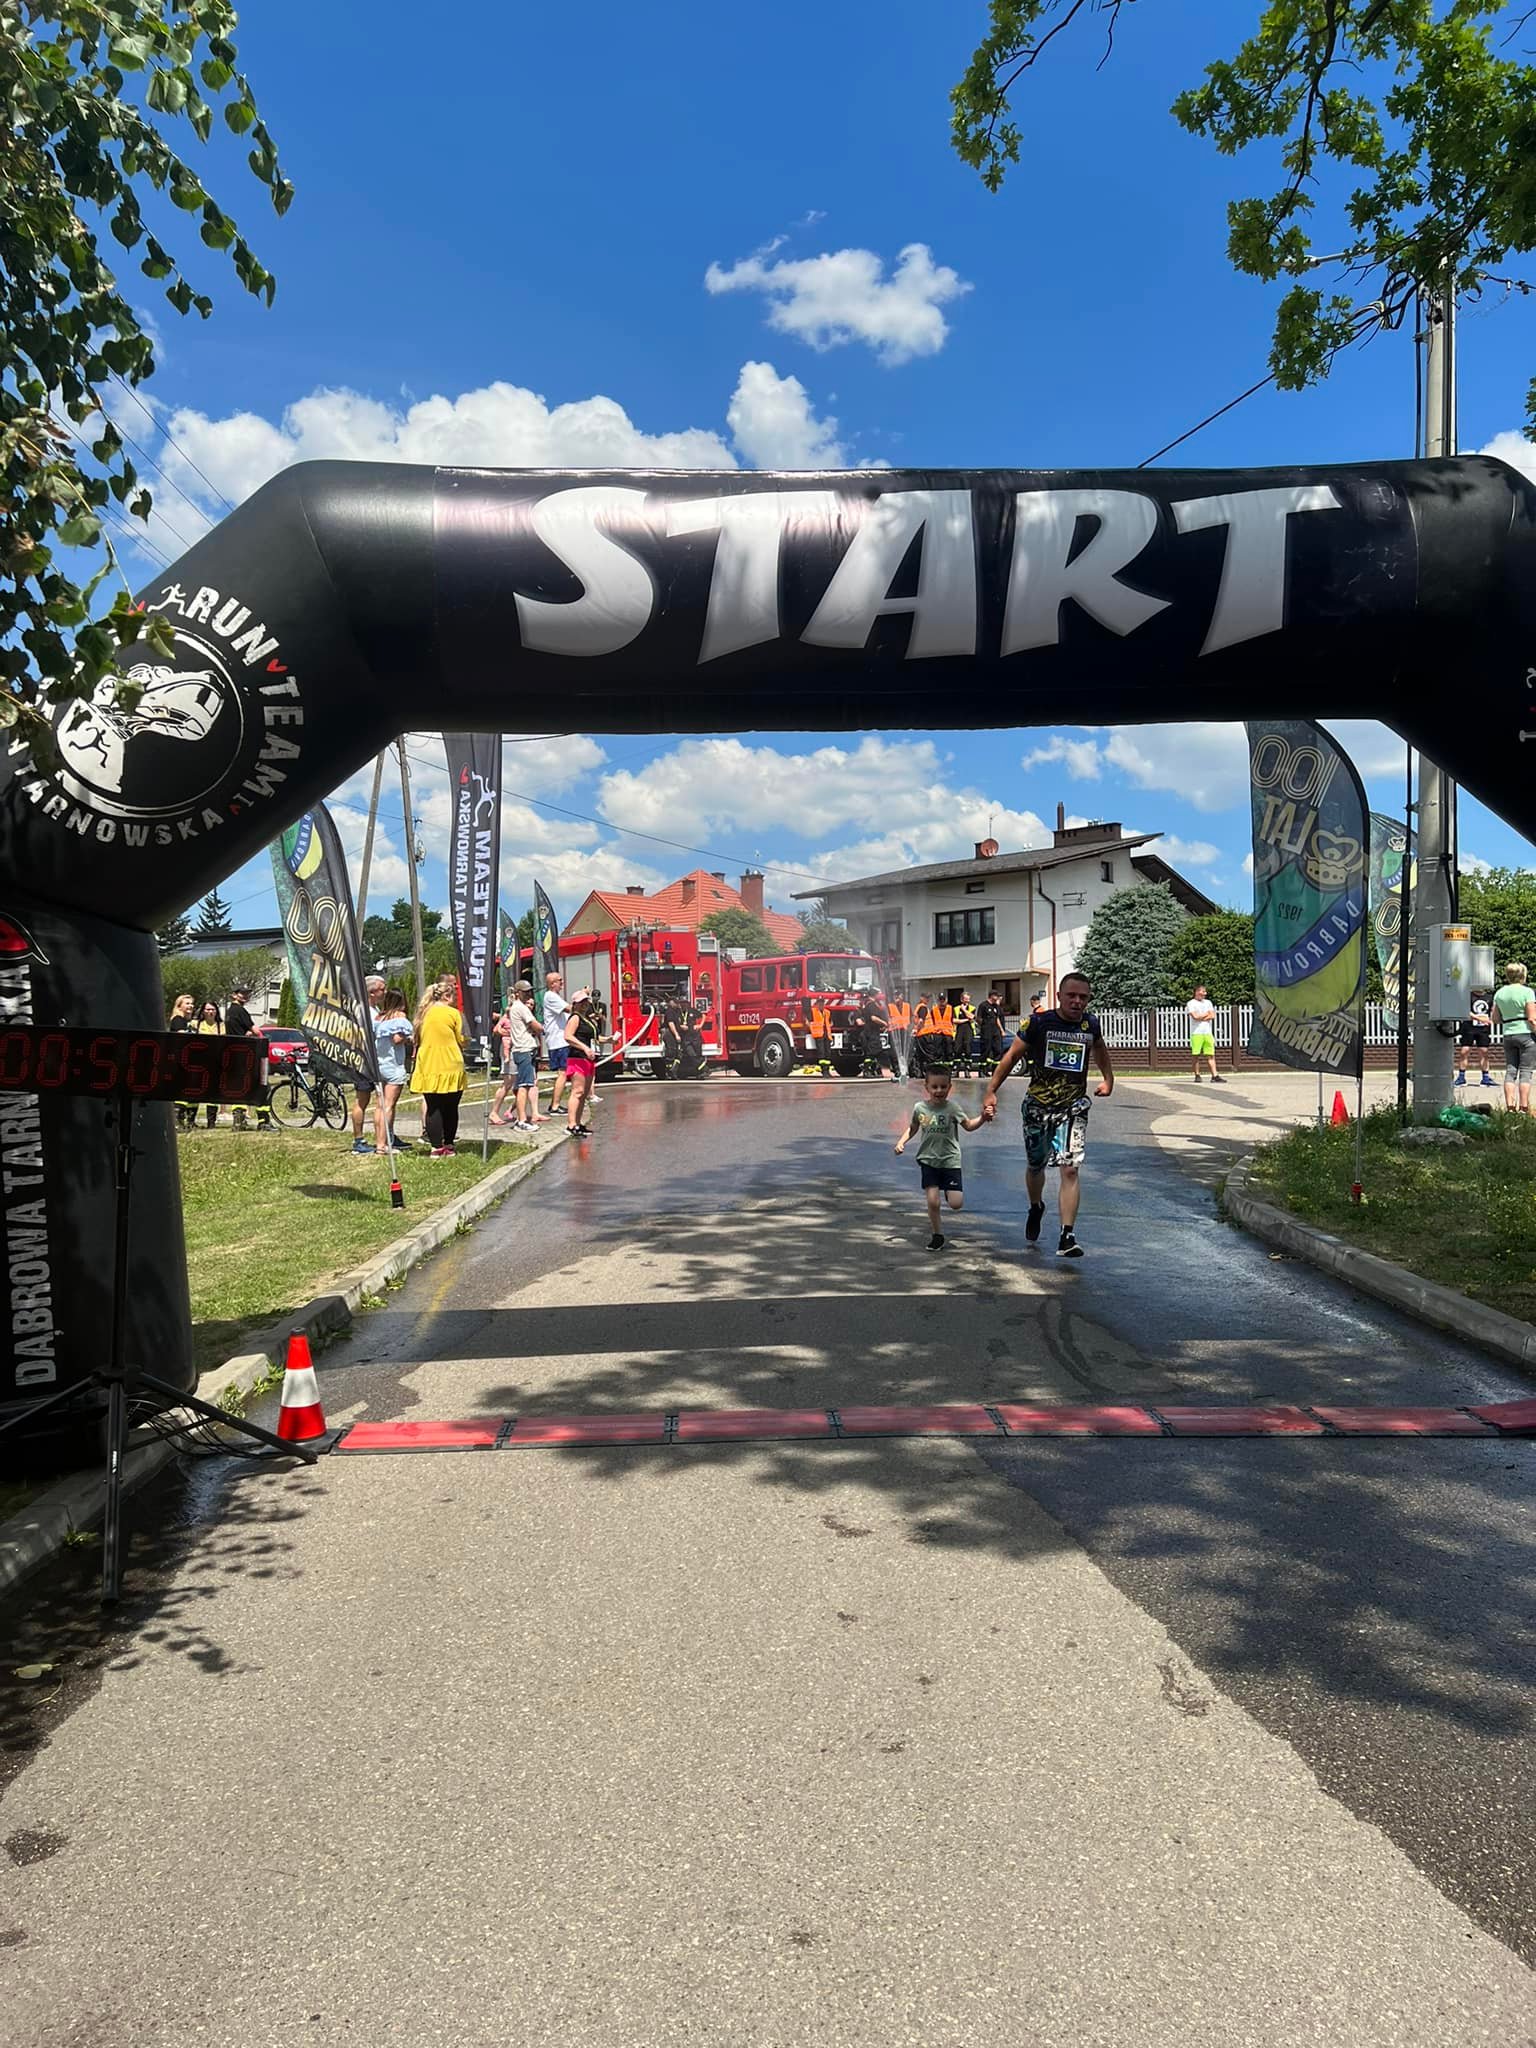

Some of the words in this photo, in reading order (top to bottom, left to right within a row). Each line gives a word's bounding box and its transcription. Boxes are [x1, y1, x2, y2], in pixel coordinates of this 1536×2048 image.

[513, 485, 1342, 664] START
[186, 586, 280, 666] RUN
[241, 675, 304, 798] TEAM
[14, 760, 225, 847] TARNOWSKA
[0, 1032, 255, 1098] 00:50:50
[1058, 1052, 1077, 1065] 28
[5, 1198, 64, 1386] DĄBROWA
